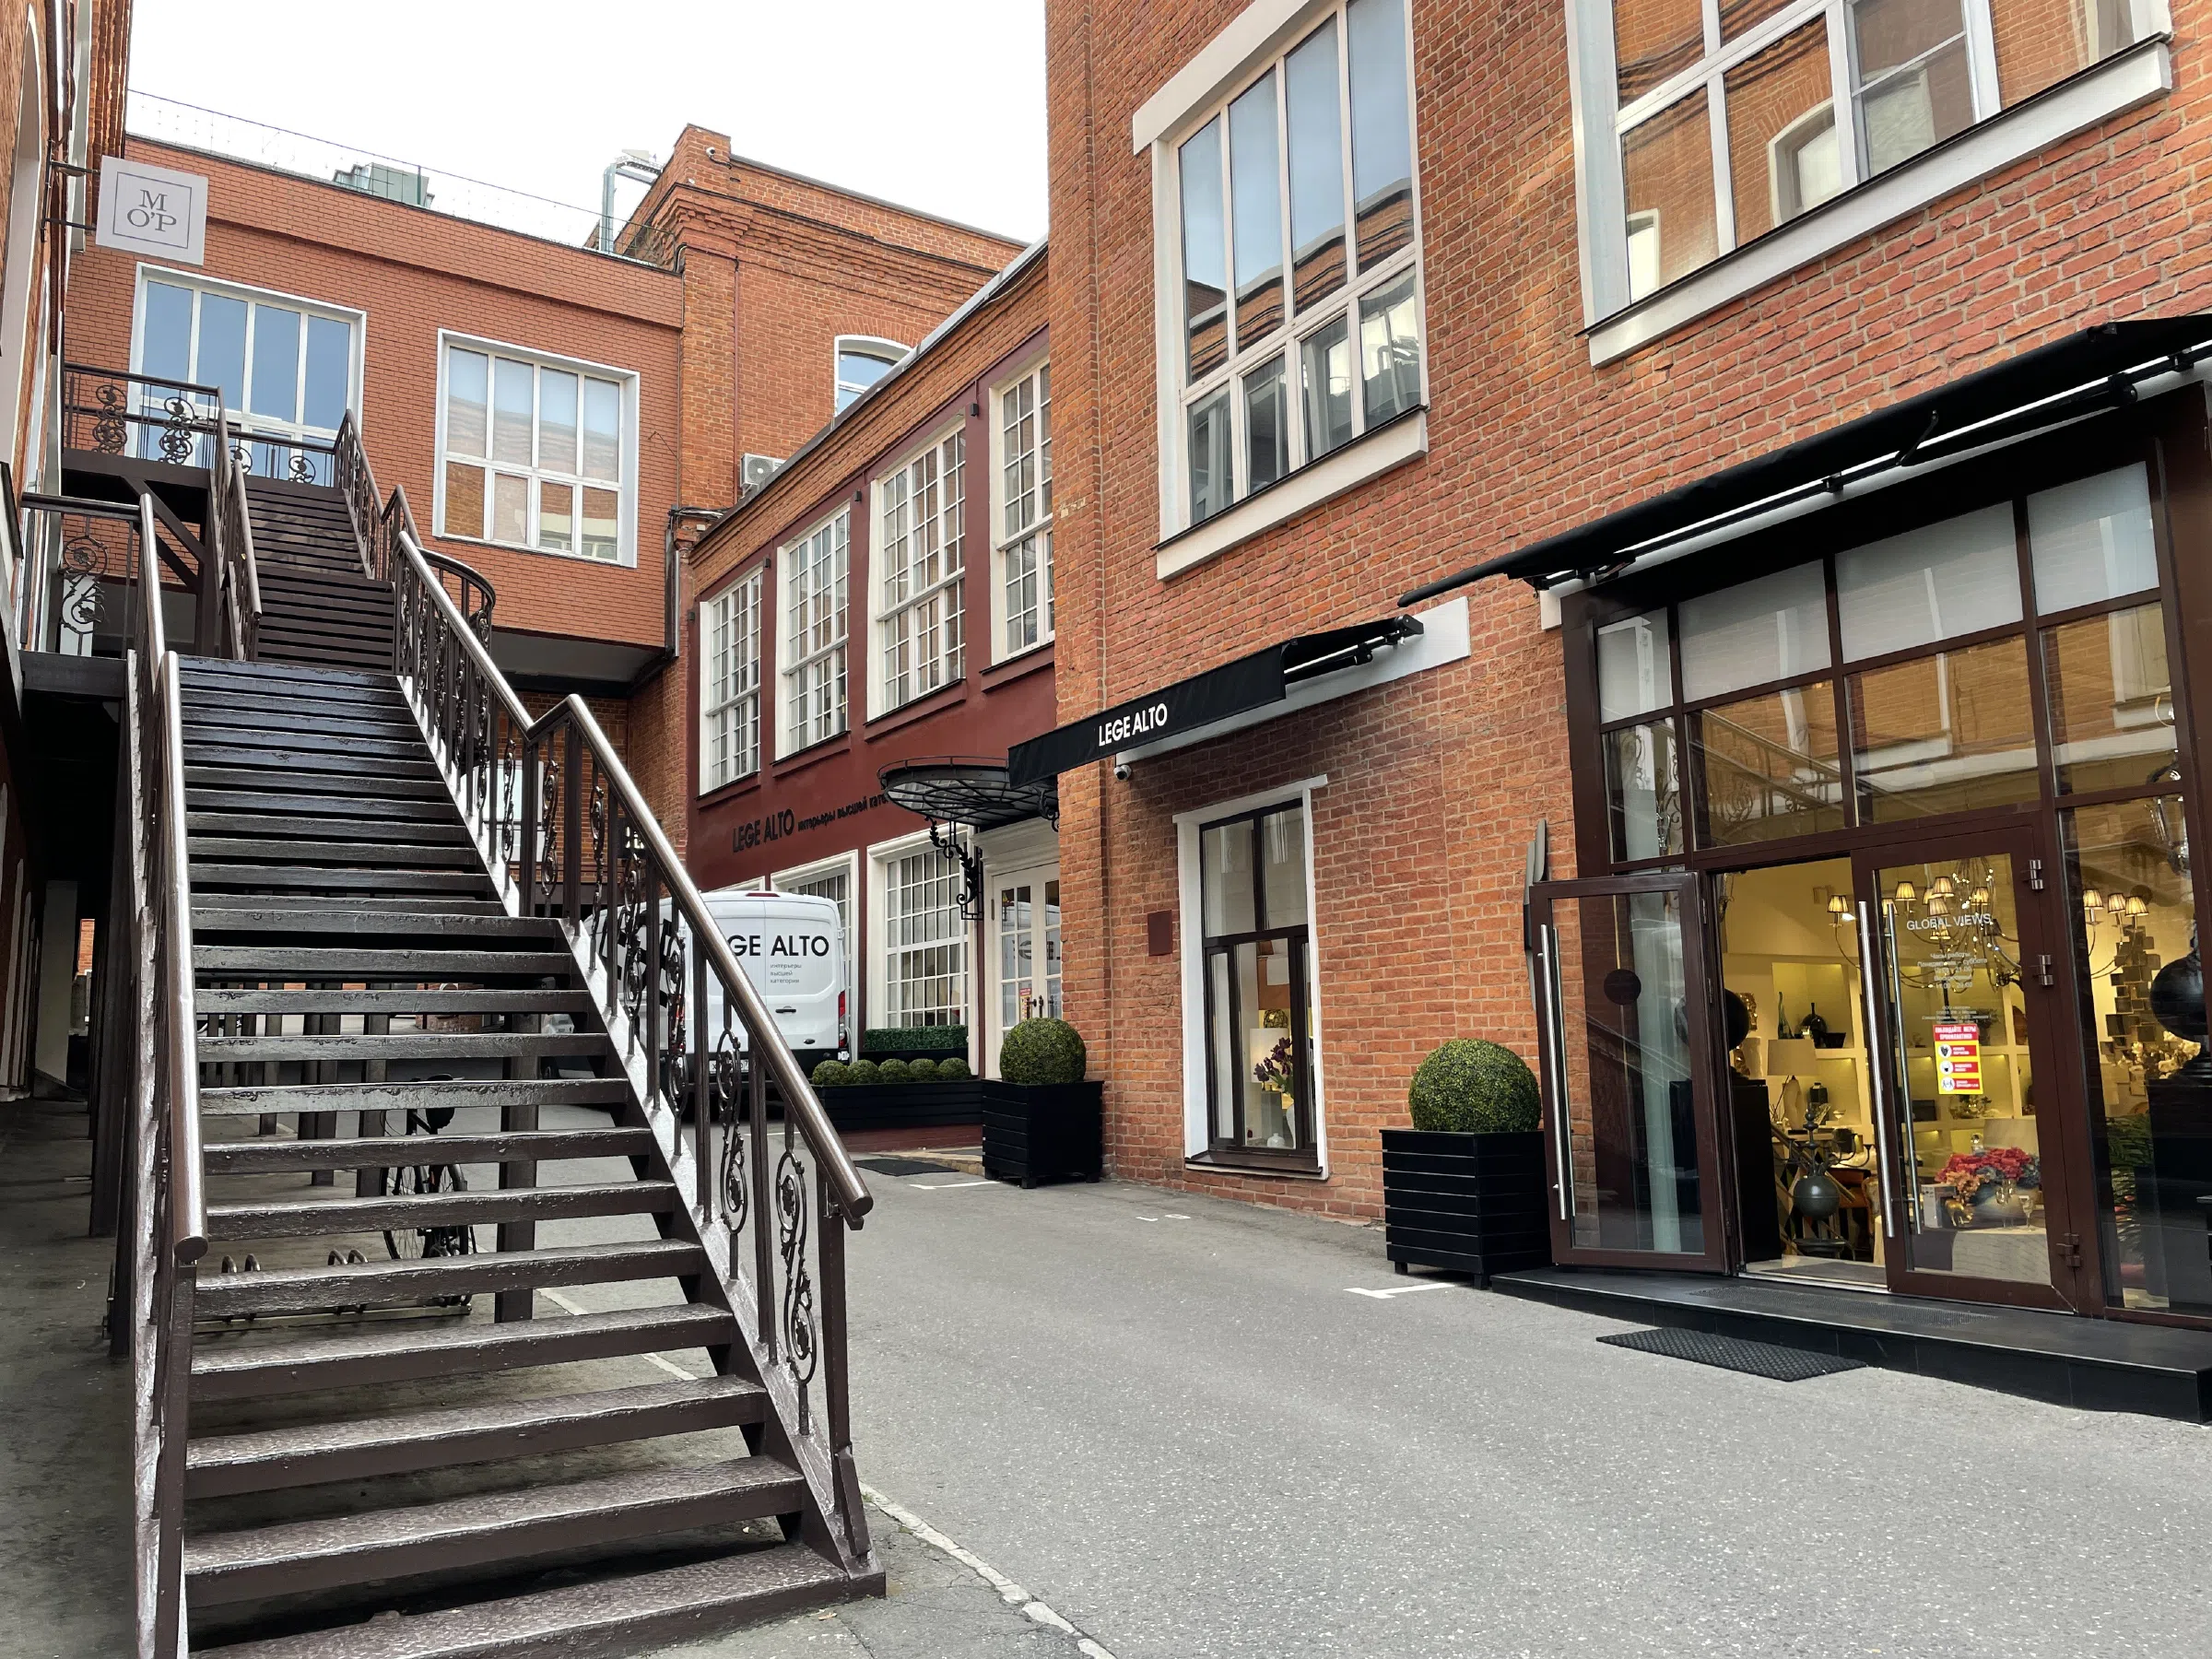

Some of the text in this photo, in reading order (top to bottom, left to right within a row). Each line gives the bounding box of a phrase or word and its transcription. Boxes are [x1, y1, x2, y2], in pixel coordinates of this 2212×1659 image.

[138, 189, 168, 212] M
[1098, 702, 1168, 747] LEGE ALTO
[732, 808, 795, 853] LEGE ALTO
[1906, 912, 1992, 931] GLOBAL VIEWS
[727, 935, 830, 957] GE ALTO
